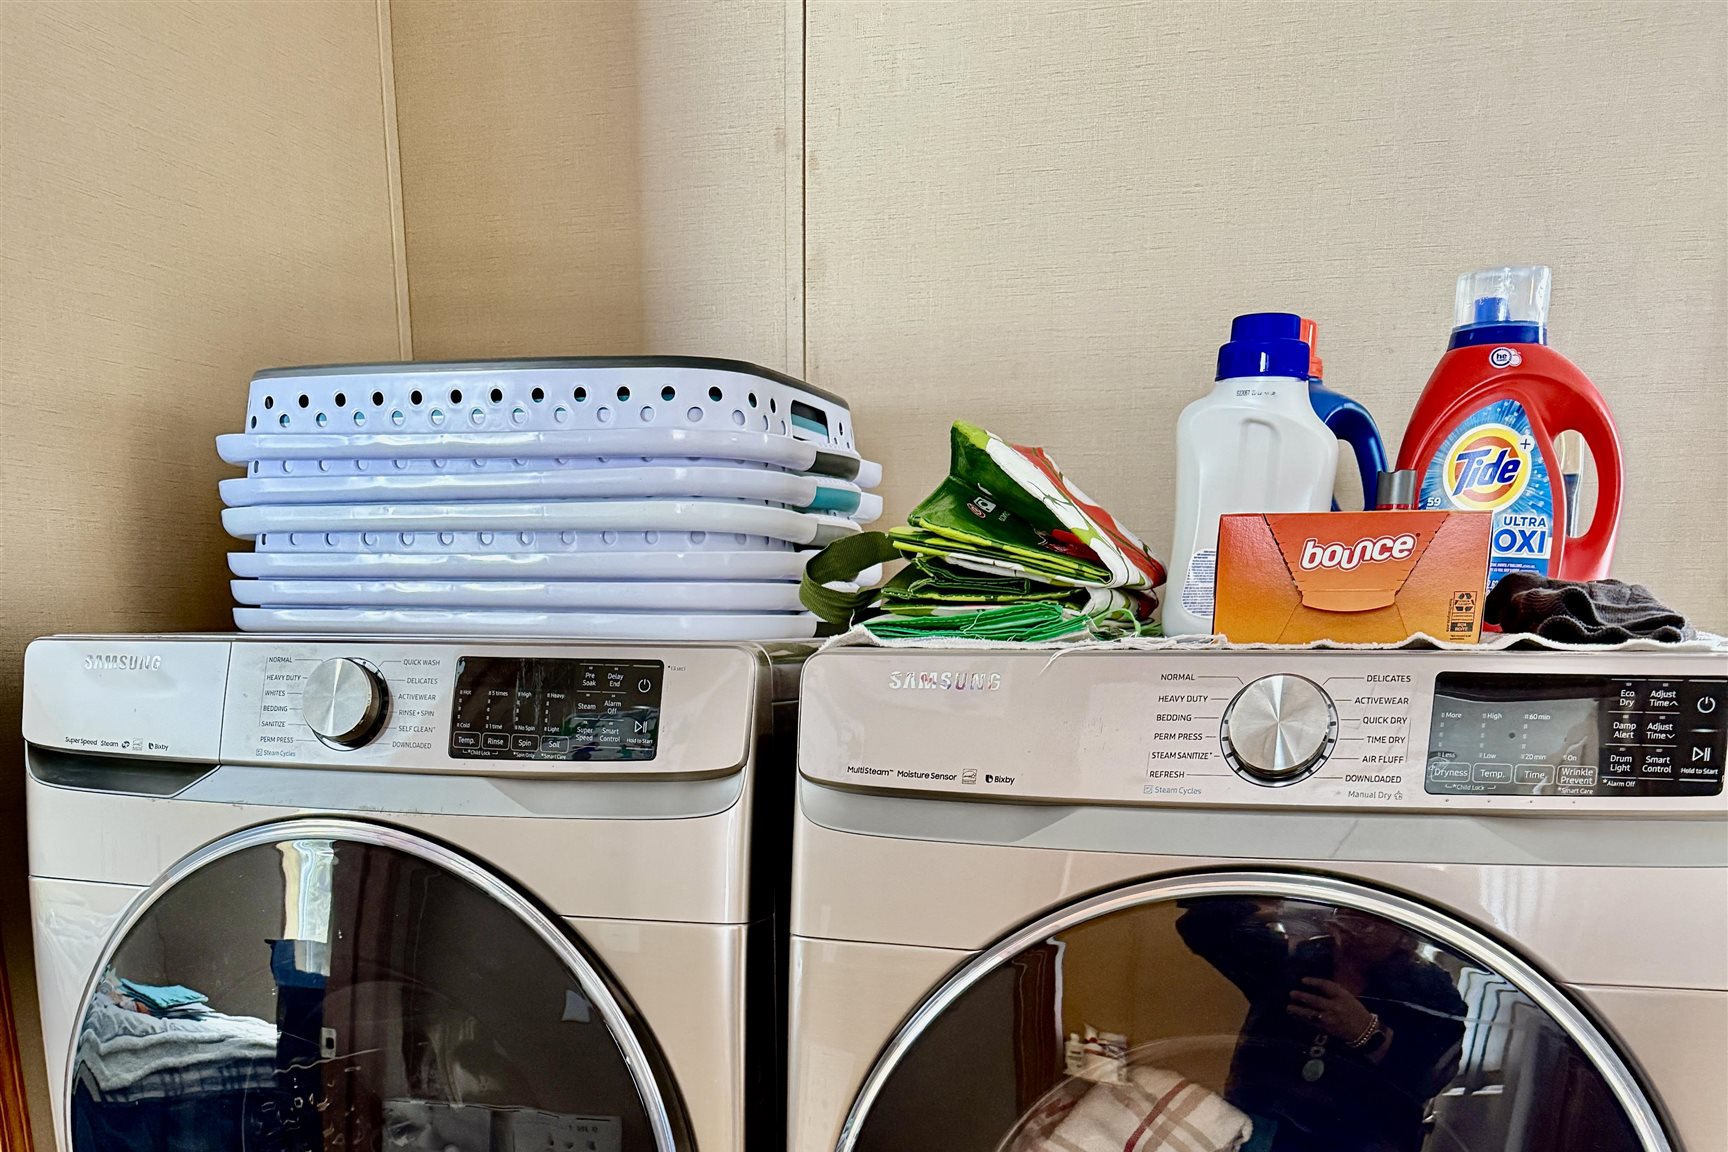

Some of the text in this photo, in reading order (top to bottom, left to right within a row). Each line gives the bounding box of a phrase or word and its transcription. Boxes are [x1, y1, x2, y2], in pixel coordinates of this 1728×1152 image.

[1452, 446, 1522, 497] Tide
[1427, 497, 1441, 507] 59
[1504, 515, 1547, 528] ULTRA
[1493, 528, 1547, 554] OXI
[1299, 533, 1417, 571] bounce
[84, 654, 162, 671] SAMSUNG
[406, 677, 439, 685] DELICATES
[607, 672, 624, 681] Delay
[889, 671, 1001, 691] SAMSUNG
[1160, 673, 1196, 681] NORMAL
[1366, 674, 1412, 683] DELICATES
[609, 680, 621, 688] End
[398, 693, 436, 701] ACTIVEWEAR
[1620, 689, 1635, 697] Eco
[1649, 690, 1677, 699] Adjust
[1158, 695, 1208, 703] HEAVY DUTY
[1354, 697, 1410, 705] ACTIVEWEAR
[1619, 699, 1635, 707] Dry
[1649, 699, 1670, 707] Time
[577, 702, 597, 710] Steam
[604, 700, 622, 708] Alarm
[398, 709, 416, 717] RINSE
[607, 707, 618, 715] Off
[1156, 714, 1192, 722] BEDDING
[1362, 716, 1408, 725] QUICK DRY
[1487, 712, 1503, 721] High
[576, 726, 594, 736] Super
[601, 727, 620, 735] Smart
[1613, 721, 1637, 732] Damp
[1646, 722, 1674, 732] Adjust
[575, 734, 594, 743] Speed
[599, 735, 621, 743] Control
[1153, 733, 1203, 741] PERM PRESS
[1613, 731, 1635, 739] Alert
[1646, 731, 1667, 739] Time
[100, 740, 119, 748] Steam
[276, 736, 294, 744] PRESS
[458, 736, 476, 745] Temp.
[487, 737, 504, 746] Rinse
[518, 739, 532, 748] Spin
[548, 740, 560, 749] Soil
[1366, 736, 1406, 744] TIME DRY
[392, 741, 432, 750] DOWNLOADED
[1151, 751, 1176, 760] STEAM
[1361, 755, 1404, 764] AIR FLUFF
[1610, 754, 1633, 763] Drum
[1645, 755, 1671, 764] Smart
[1433, 767, 1468, 778] Dryness
[1561, 767, 1594, 777] Wrinkle
[1610, 763, 1631, 773] Light
[1642, 764, 1672, 773] Control
[1702, 767, 1719, 775] Start
[897, 770, 930, 779] Moisture
[930, 771, 957, 781] Sensor
[994, 775, 1015, 785] Bixby
[1149, 771, 1185, 779] REFRESH
[1480, 768, 1506, 779] Temp.
[1524, 770, 1545, 779] Time
[1345, 774, 1402, 784] DOWNLOADED
[1560, 776, 1593, 785] Prevent
[1624, 780, 1636, 788] Off
[1154, 785, 1202, 796] Steam Cycles
[1348, 790, 1392, 801] Manual Dry
